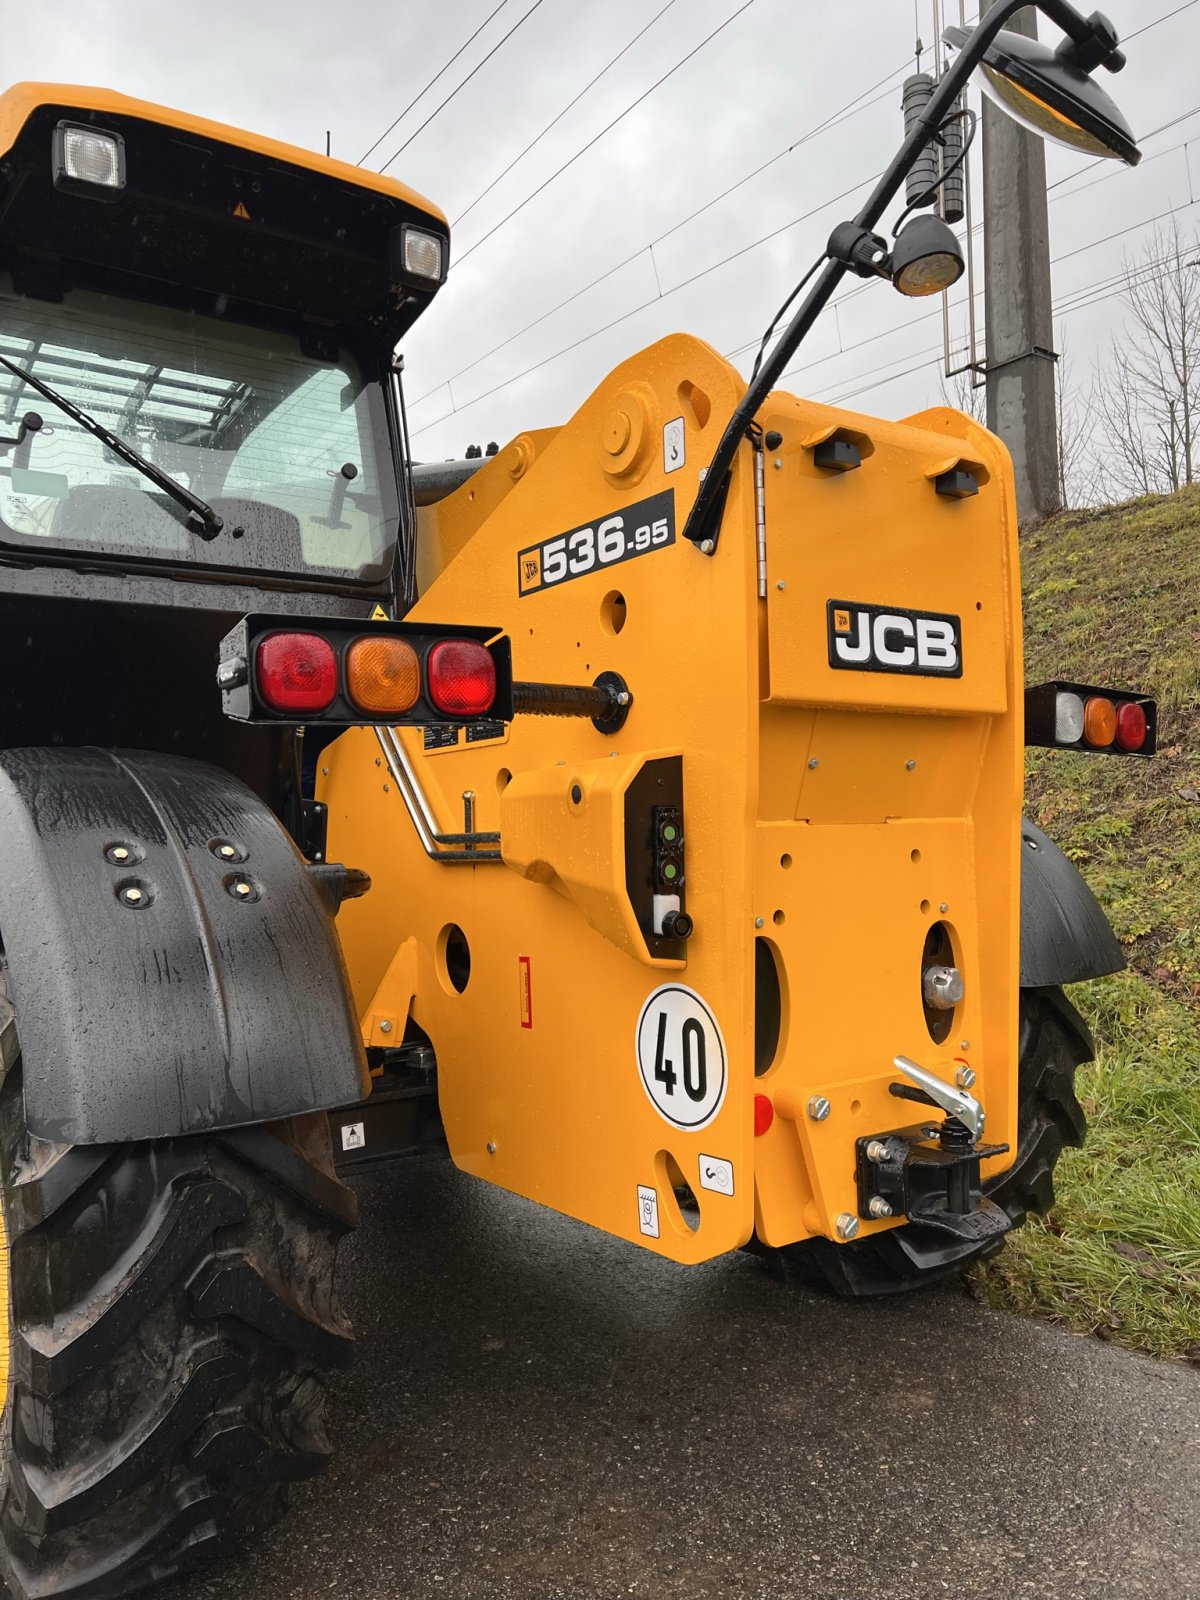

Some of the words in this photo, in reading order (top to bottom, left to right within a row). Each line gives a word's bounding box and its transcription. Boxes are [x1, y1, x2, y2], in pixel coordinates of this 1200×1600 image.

[525, 562, 537, 580] JCB
[835, 611, 957, 668] JCB
[654, 1012, 707, 1102] 40
